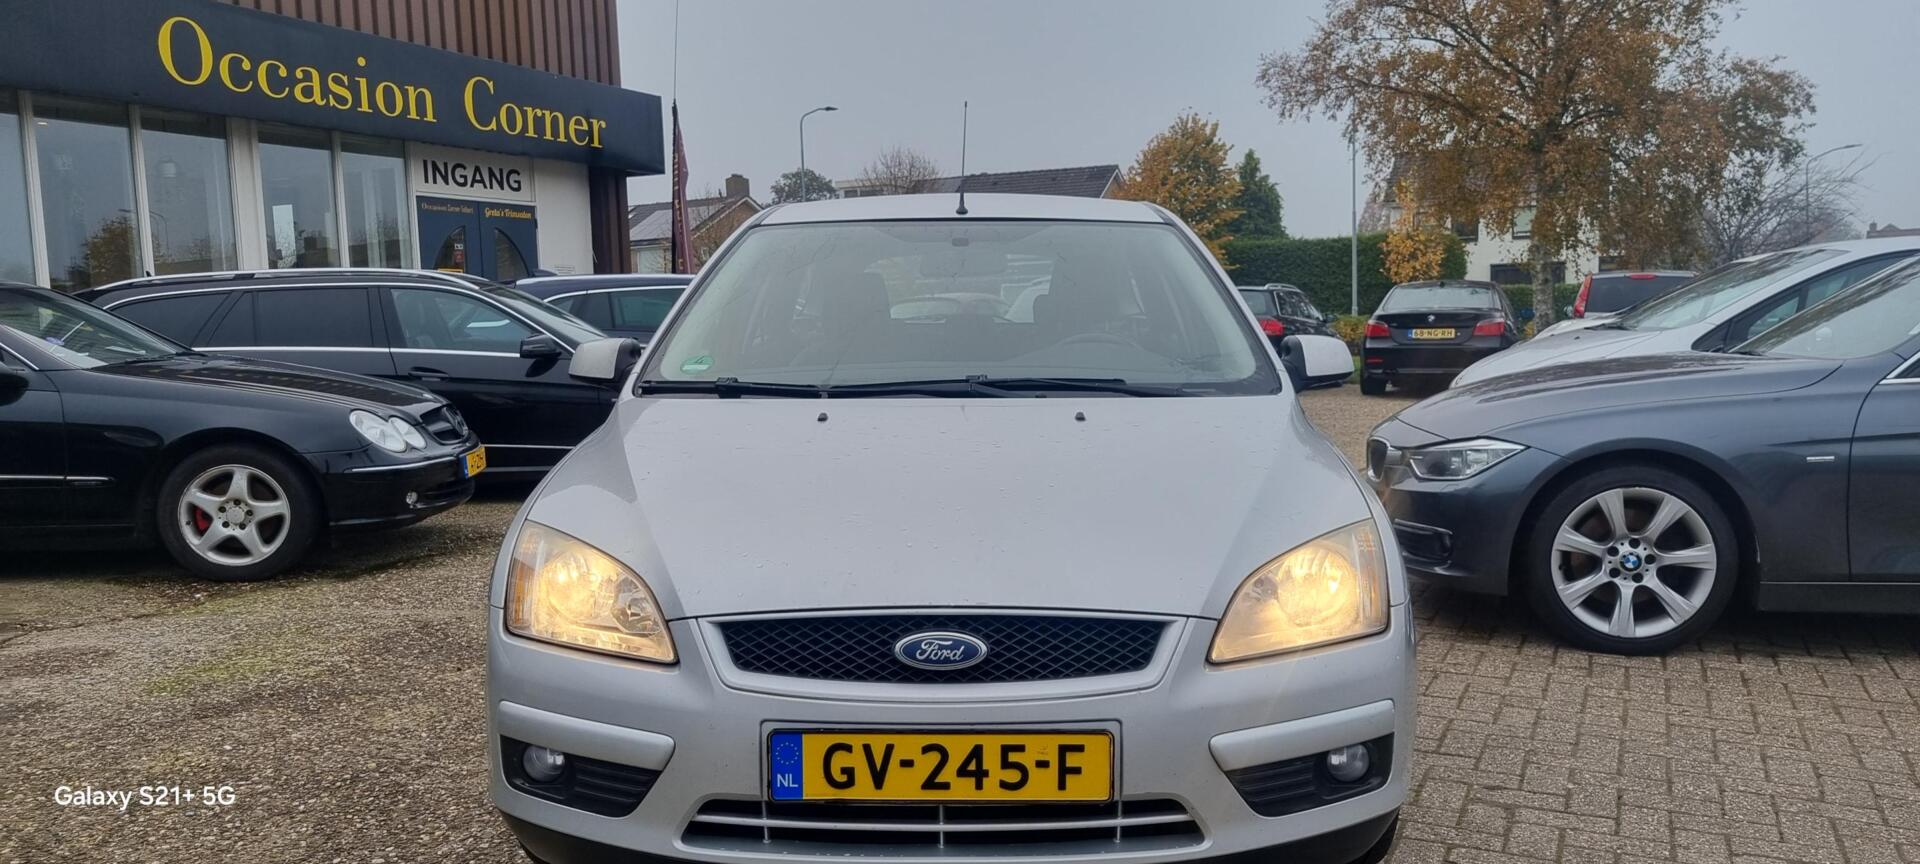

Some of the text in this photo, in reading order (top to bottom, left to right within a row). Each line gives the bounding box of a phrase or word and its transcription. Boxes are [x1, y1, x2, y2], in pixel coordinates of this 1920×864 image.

[158, 16, 606, 148] Occasion Corner
[423, 159, 522, 192] INGANG
[916, 640, 965, 662] Ford
[777, 773, 799, 788] NL
[822, 742, 1086, 791] GV-245-F
